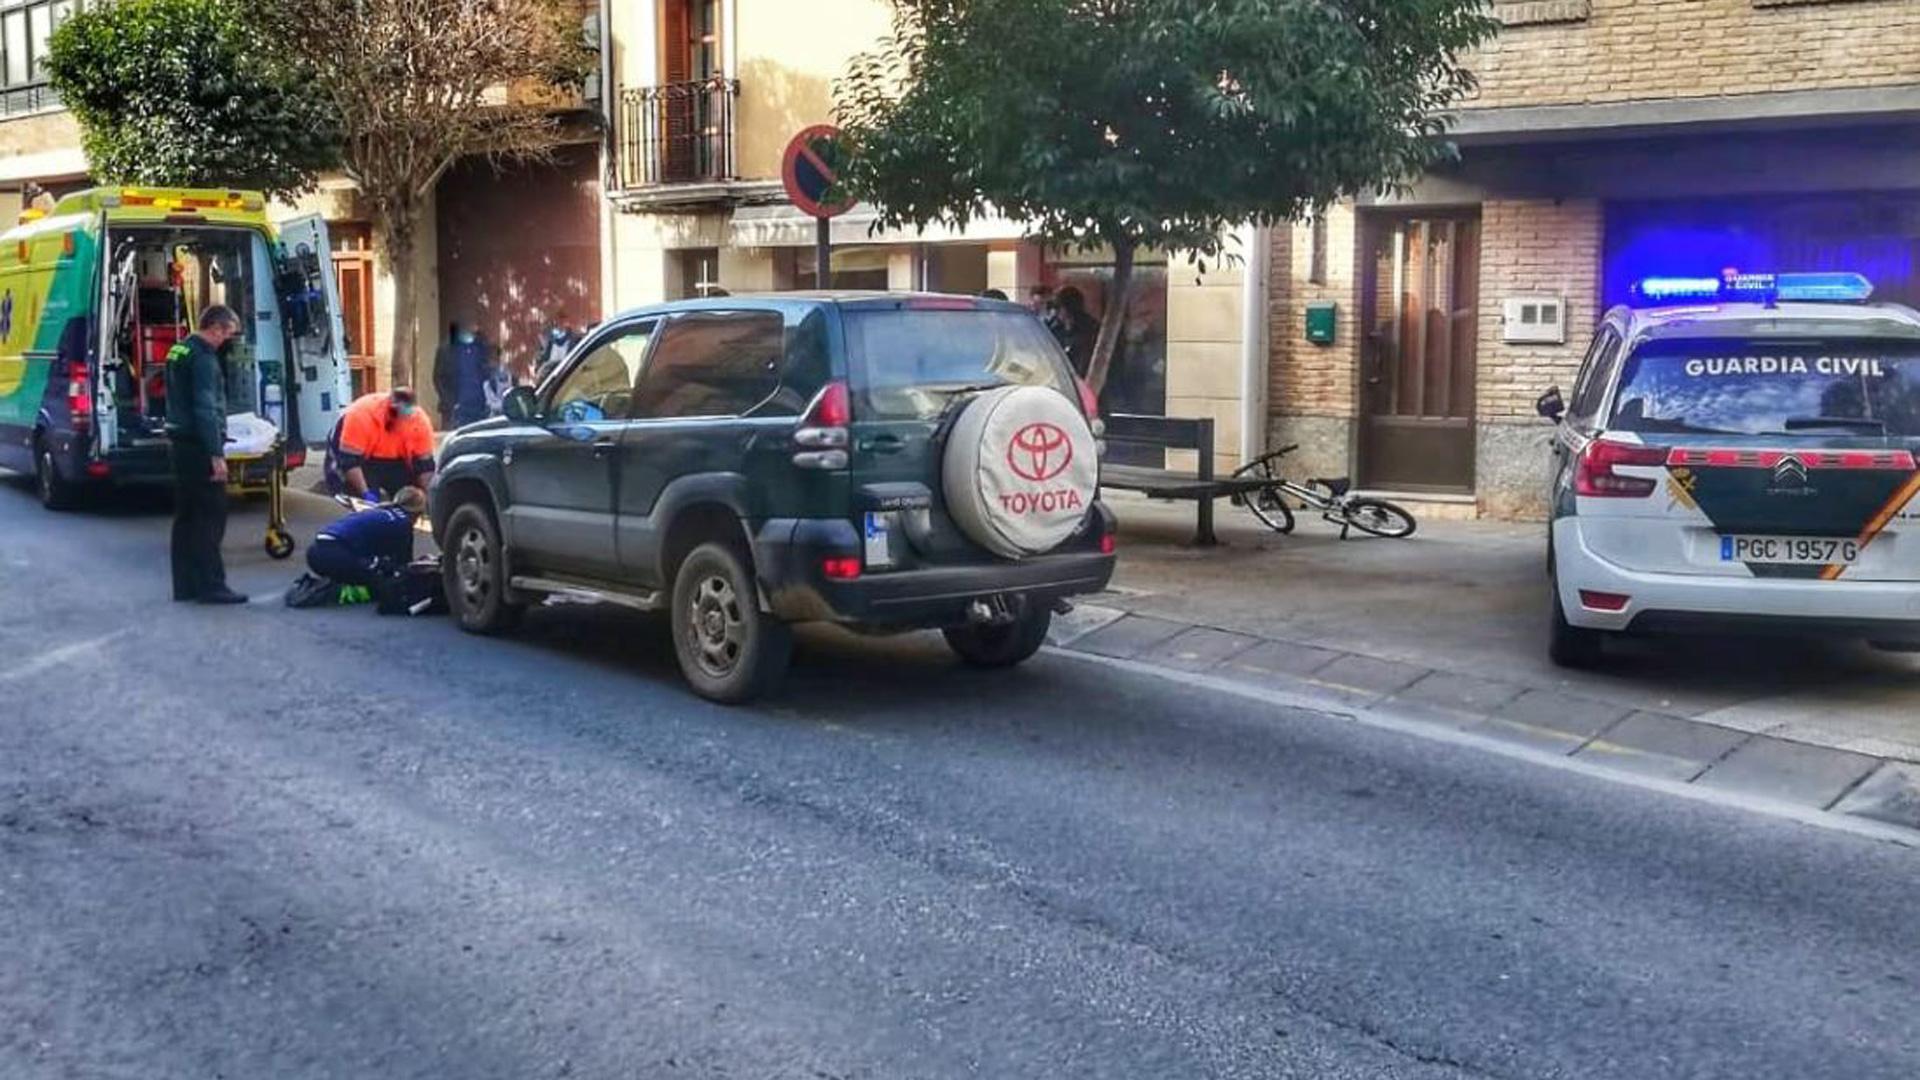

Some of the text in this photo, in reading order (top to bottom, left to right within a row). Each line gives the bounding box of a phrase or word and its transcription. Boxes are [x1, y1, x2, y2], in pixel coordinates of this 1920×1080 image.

[1685, 356, 1885, 377] GUARDIA CIVIL
[998, 489, 1083, 514] TOYOTA
[1736, 538, 1857, 562] PGC 1957 G
